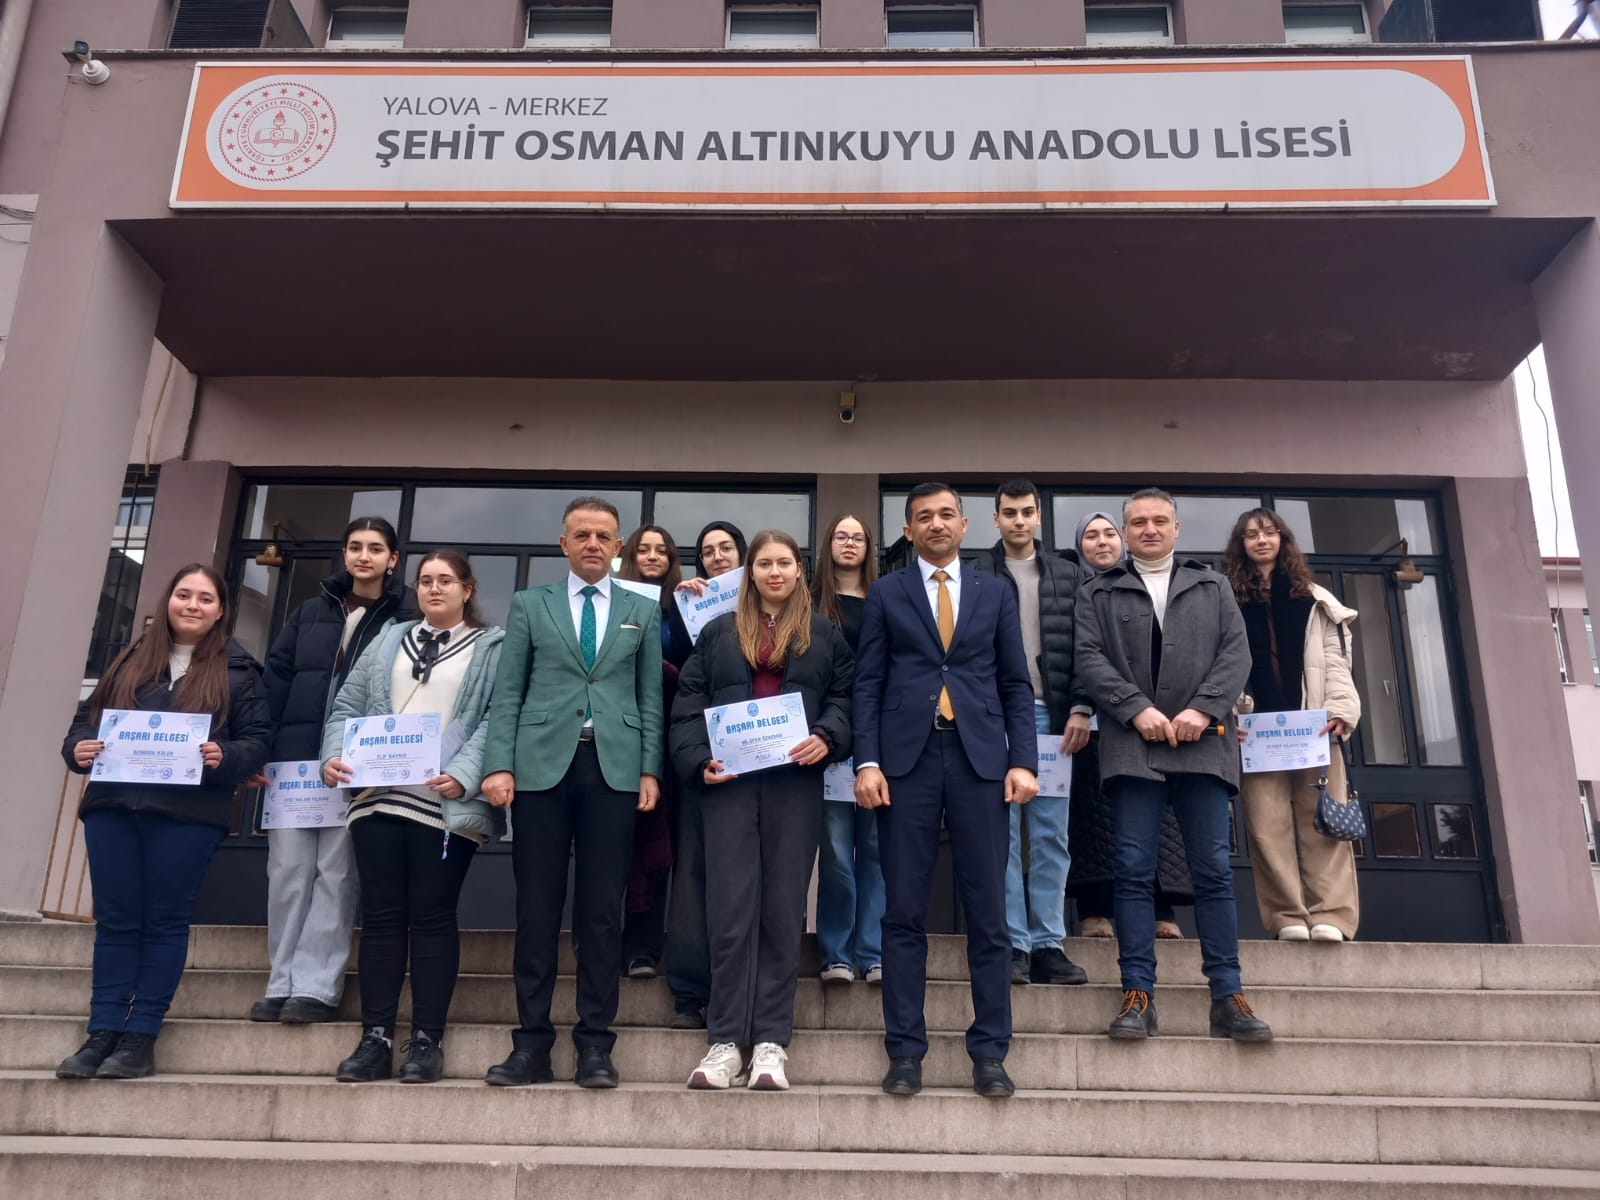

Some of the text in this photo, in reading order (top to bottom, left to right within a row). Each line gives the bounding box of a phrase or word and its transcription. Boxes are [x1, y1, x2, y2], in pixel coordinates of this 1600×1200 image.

[383, 96, 481, 116] YALOVA
[504, 96, 609, 116] MERKEZ
[375, 118, 1353, 168] ŞEHİT OSMAN ALTINKUYU ANADOLU LİSESİ
[694, 596, 719, 611] BAŞARI
[725, 713, 789, 734] BAŞARI BELGESİ
[118, 731, 190, 743] BAŞARI BELGESİ
[359, 732, 423, 747] BAŞARI BELGESİ
[1255, 727, 1313, 739] BAŞARI BELGESİ
[279, 780, 301, 790] BAŞARI
